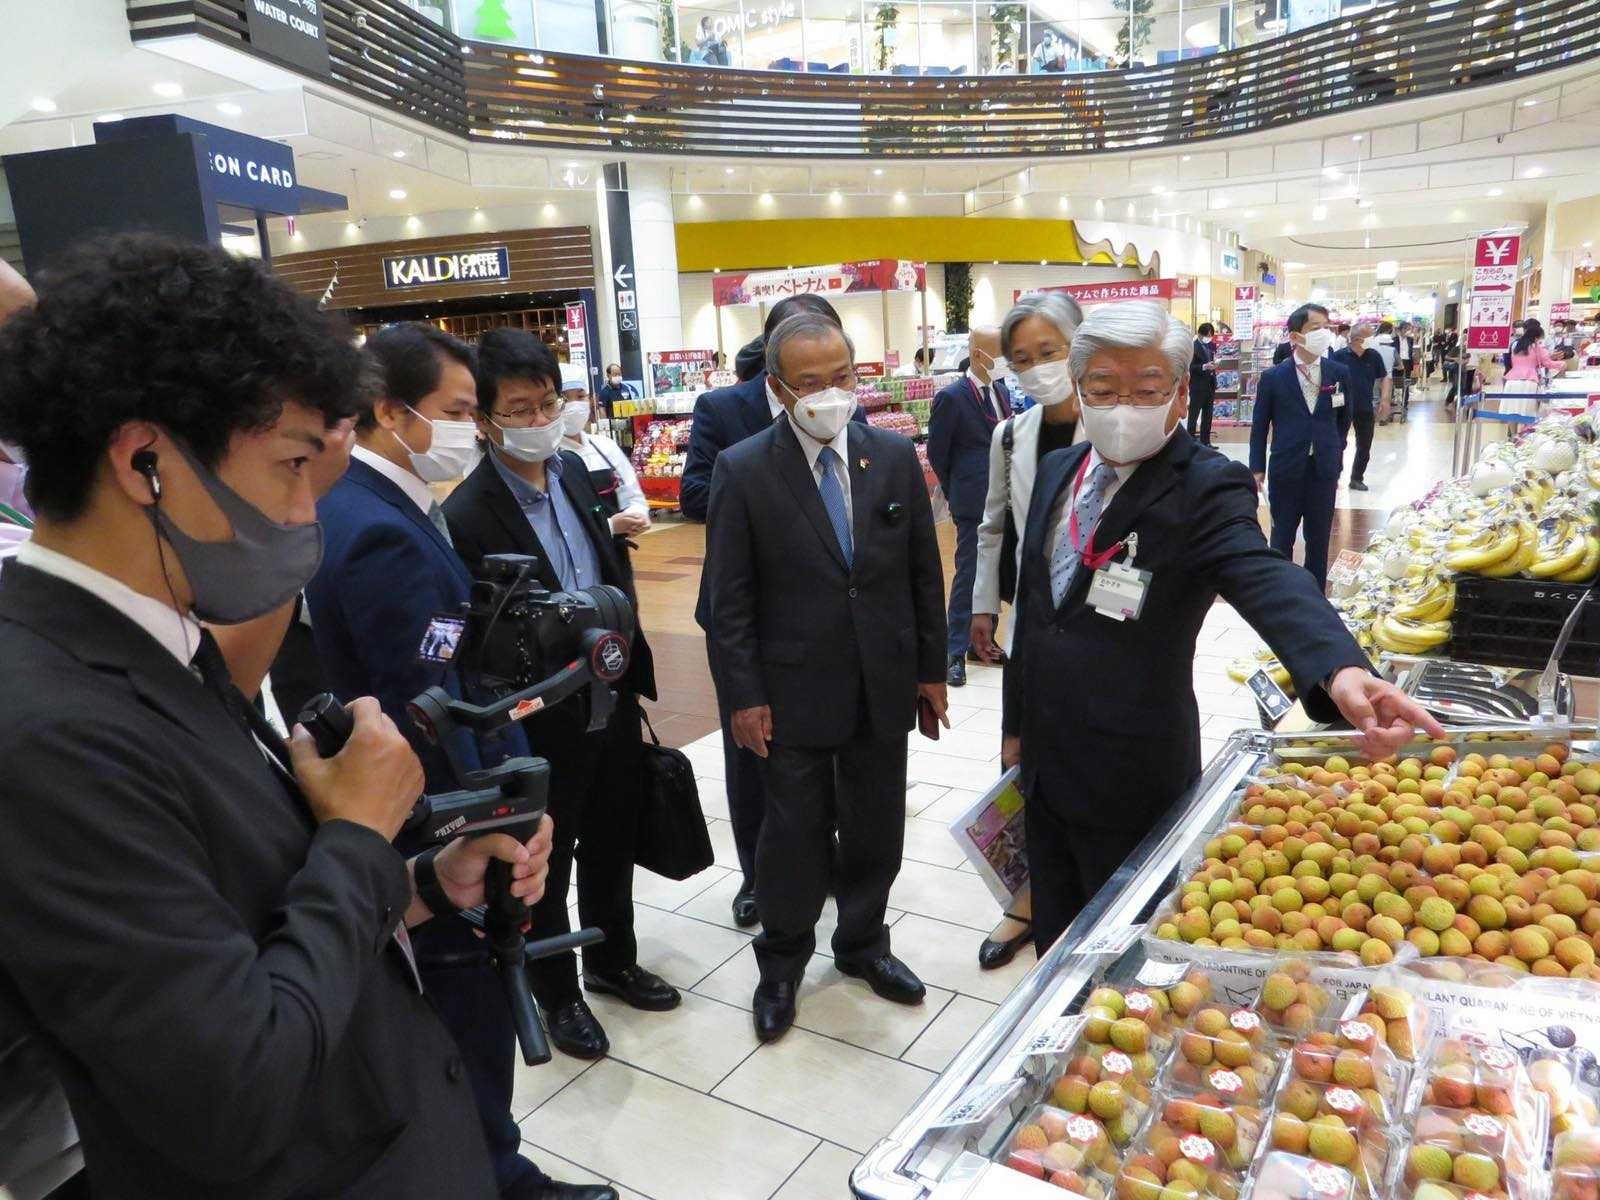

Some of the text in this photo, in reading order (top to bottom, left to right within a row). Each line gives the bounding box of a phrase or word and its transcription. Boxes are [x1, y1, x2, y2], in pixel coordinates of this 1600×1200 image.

[253, 0, 288, 25] WATER
[289, 14, 319, 39] COURT
[208, 152, 293, 189] ON CARD
[391, 255, 459, 285] KALDI
[462, 262, 501, 278] FARM
